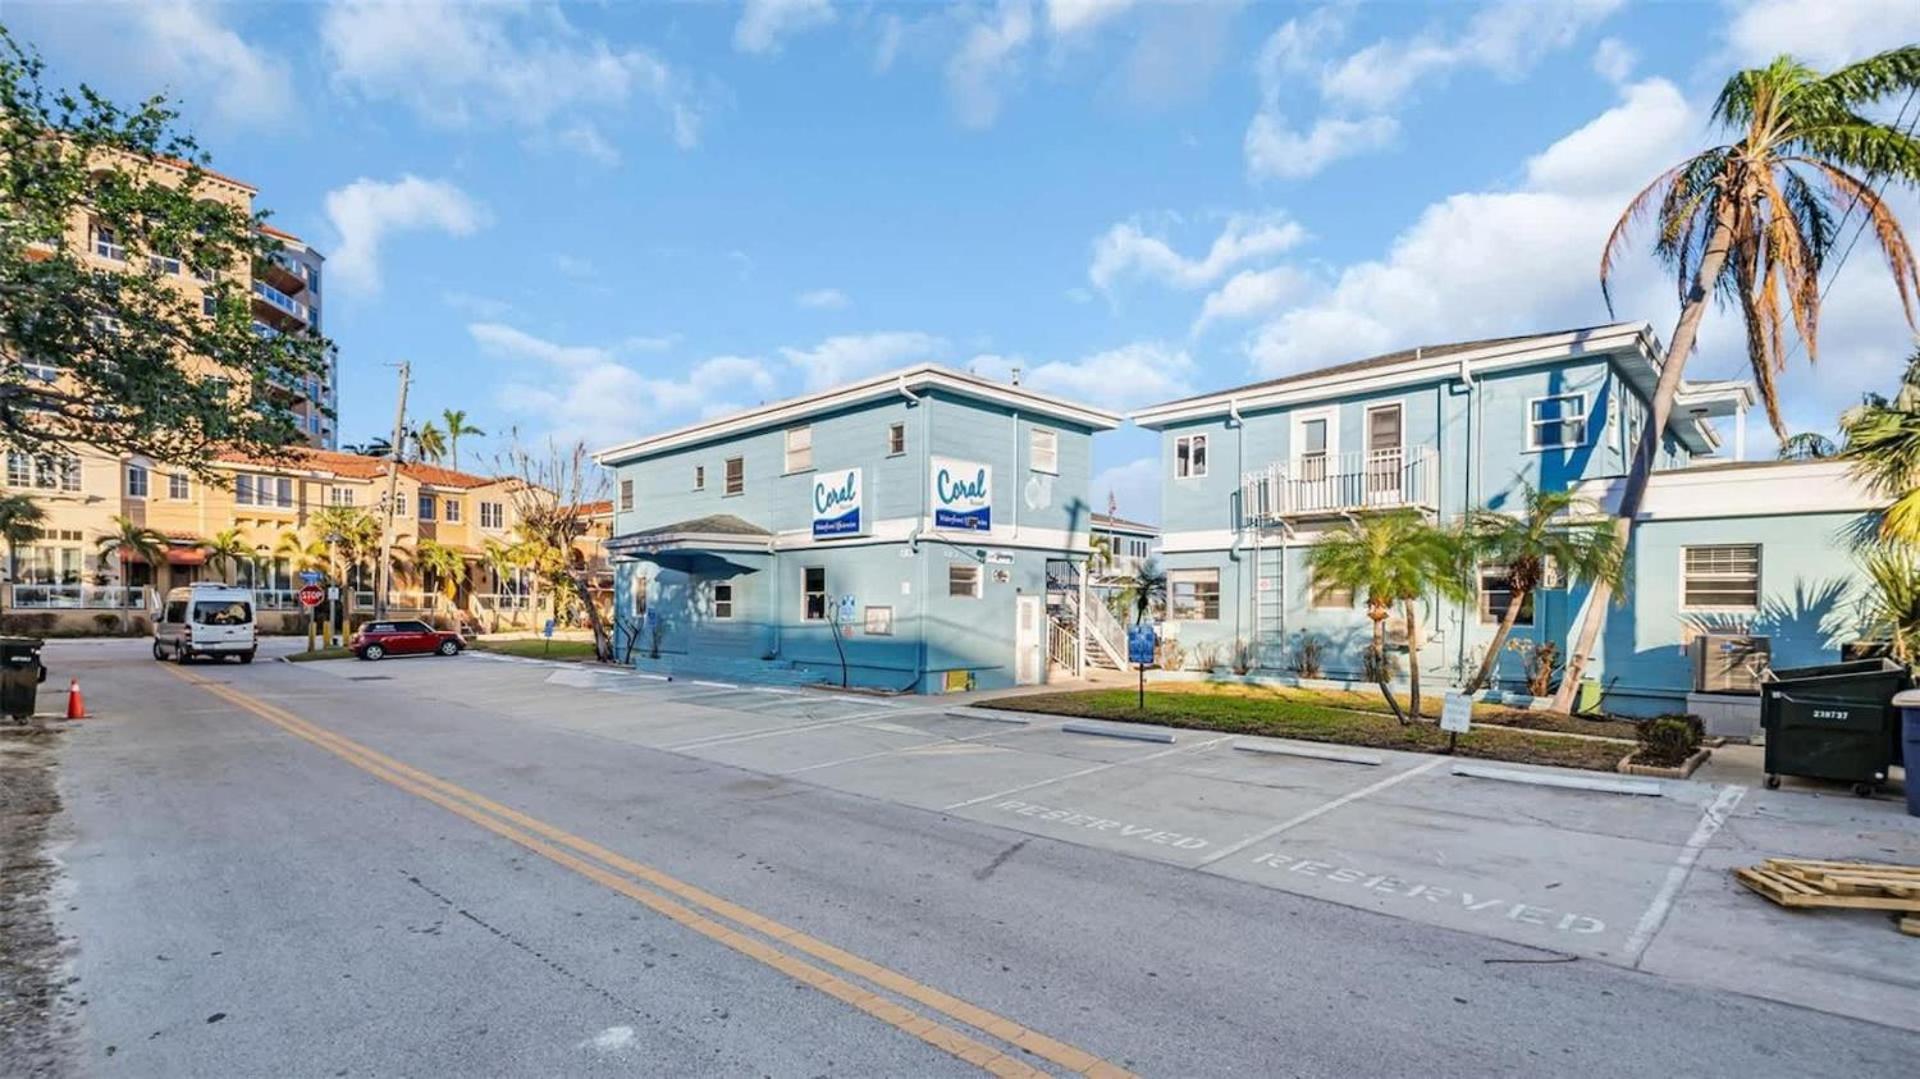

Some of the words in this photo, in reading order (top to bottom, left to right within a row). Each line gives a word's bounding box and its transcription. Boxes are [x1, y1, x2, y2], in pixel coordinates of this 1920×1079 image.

[815, 471, 856, 514] Coral
[937, 468, 986, 504] Coral
[301, 591, 321, 599] STOP
[993, 800, 1208, 849] RESERVED
[1253, 853, 1605, 933] RESERVED
